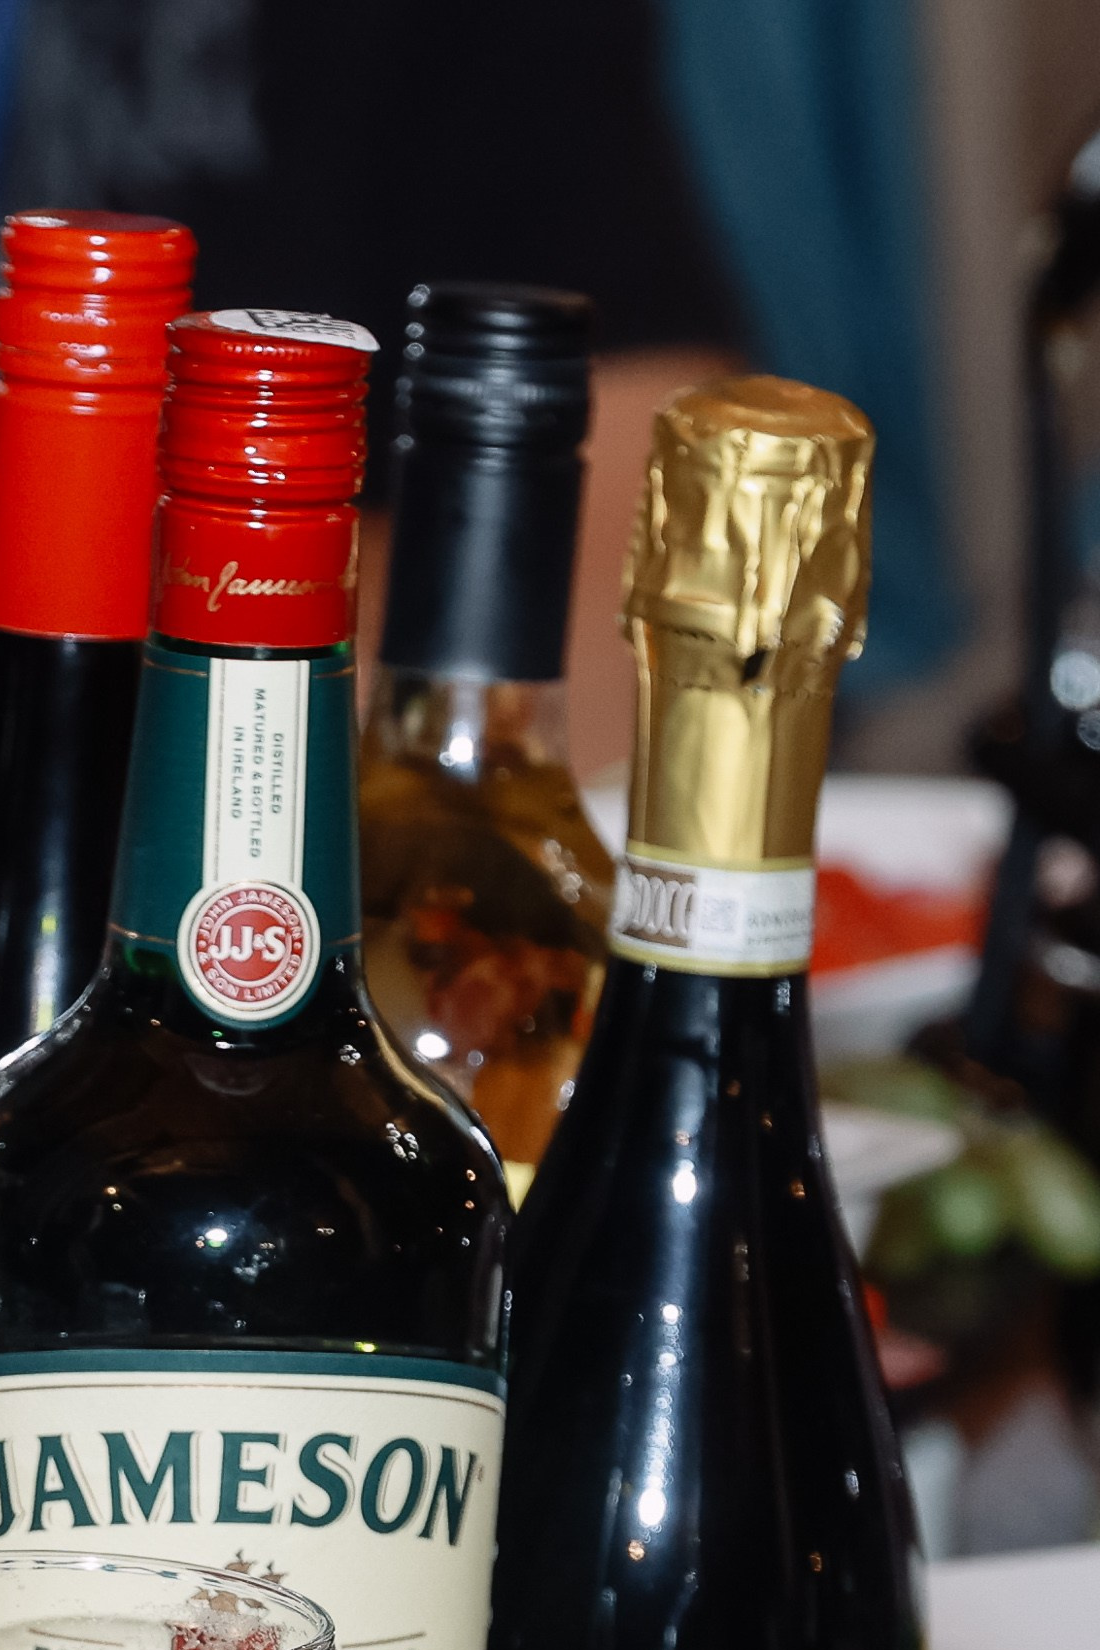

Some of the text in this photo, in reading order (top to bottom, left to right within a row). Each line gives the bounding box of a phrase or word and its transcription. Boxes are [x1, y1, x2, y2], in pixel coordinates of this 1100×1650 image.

[231, 726, 245, 819] IN IRELAND
[249, 688, 266, 858] MATURED & BOTTLED
[271, 733, 284, 814] DISTILLED
[199, 890, 303, 941] JOHN JAMESON
[205, 967, 240, 998] SON
[243, 954, 302, 1001] LIMITED
